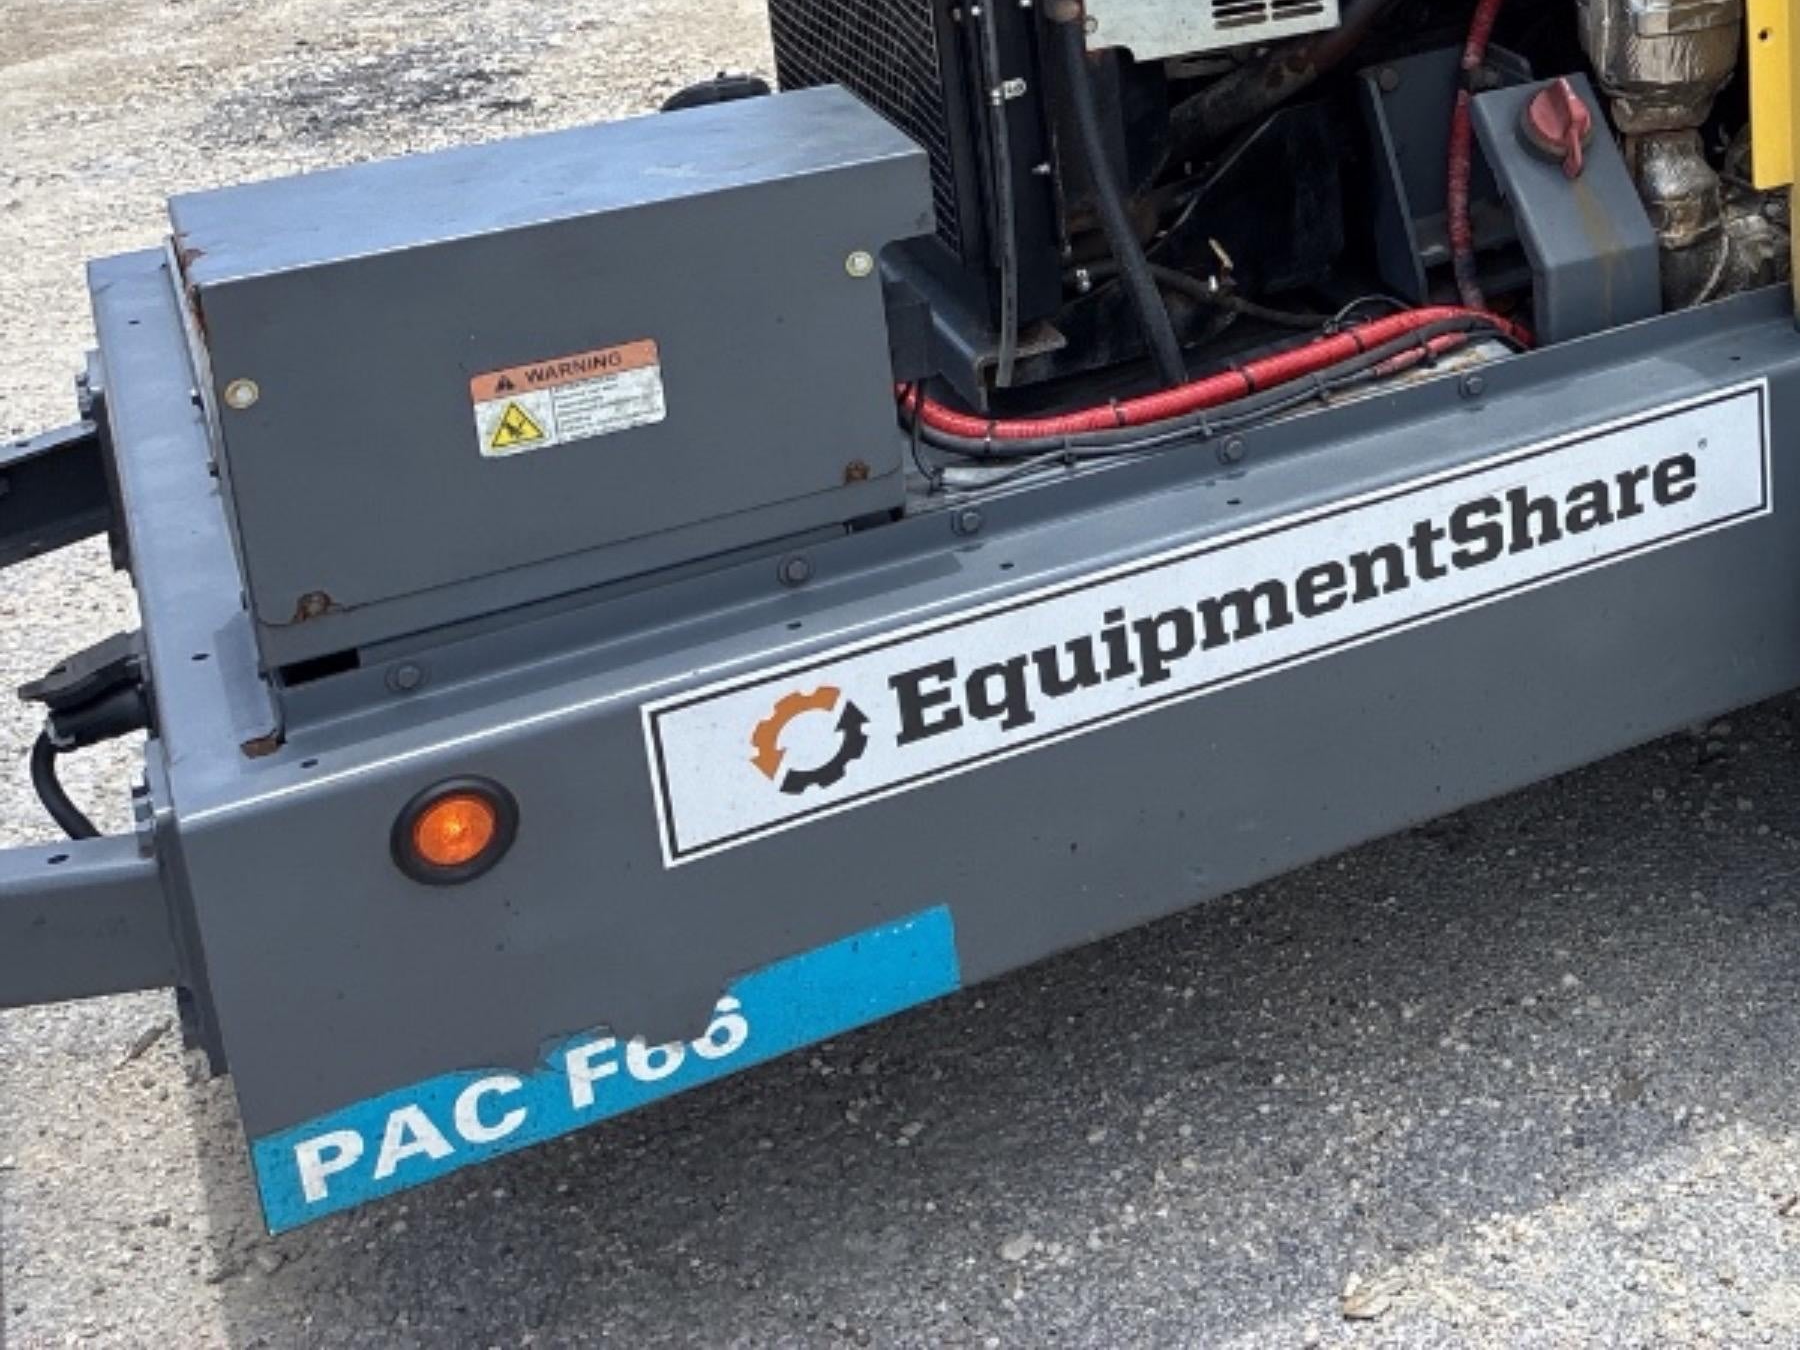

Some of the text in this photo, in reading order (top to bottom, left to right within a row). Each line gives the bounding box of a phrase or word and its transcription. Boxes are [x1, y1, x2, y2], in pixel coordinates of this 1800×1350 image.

[524, 351, 622, 383] WARNING
[888, 453, 1697, 747] EquipmentShare
[293, 1075, 529, 1204] PAC
